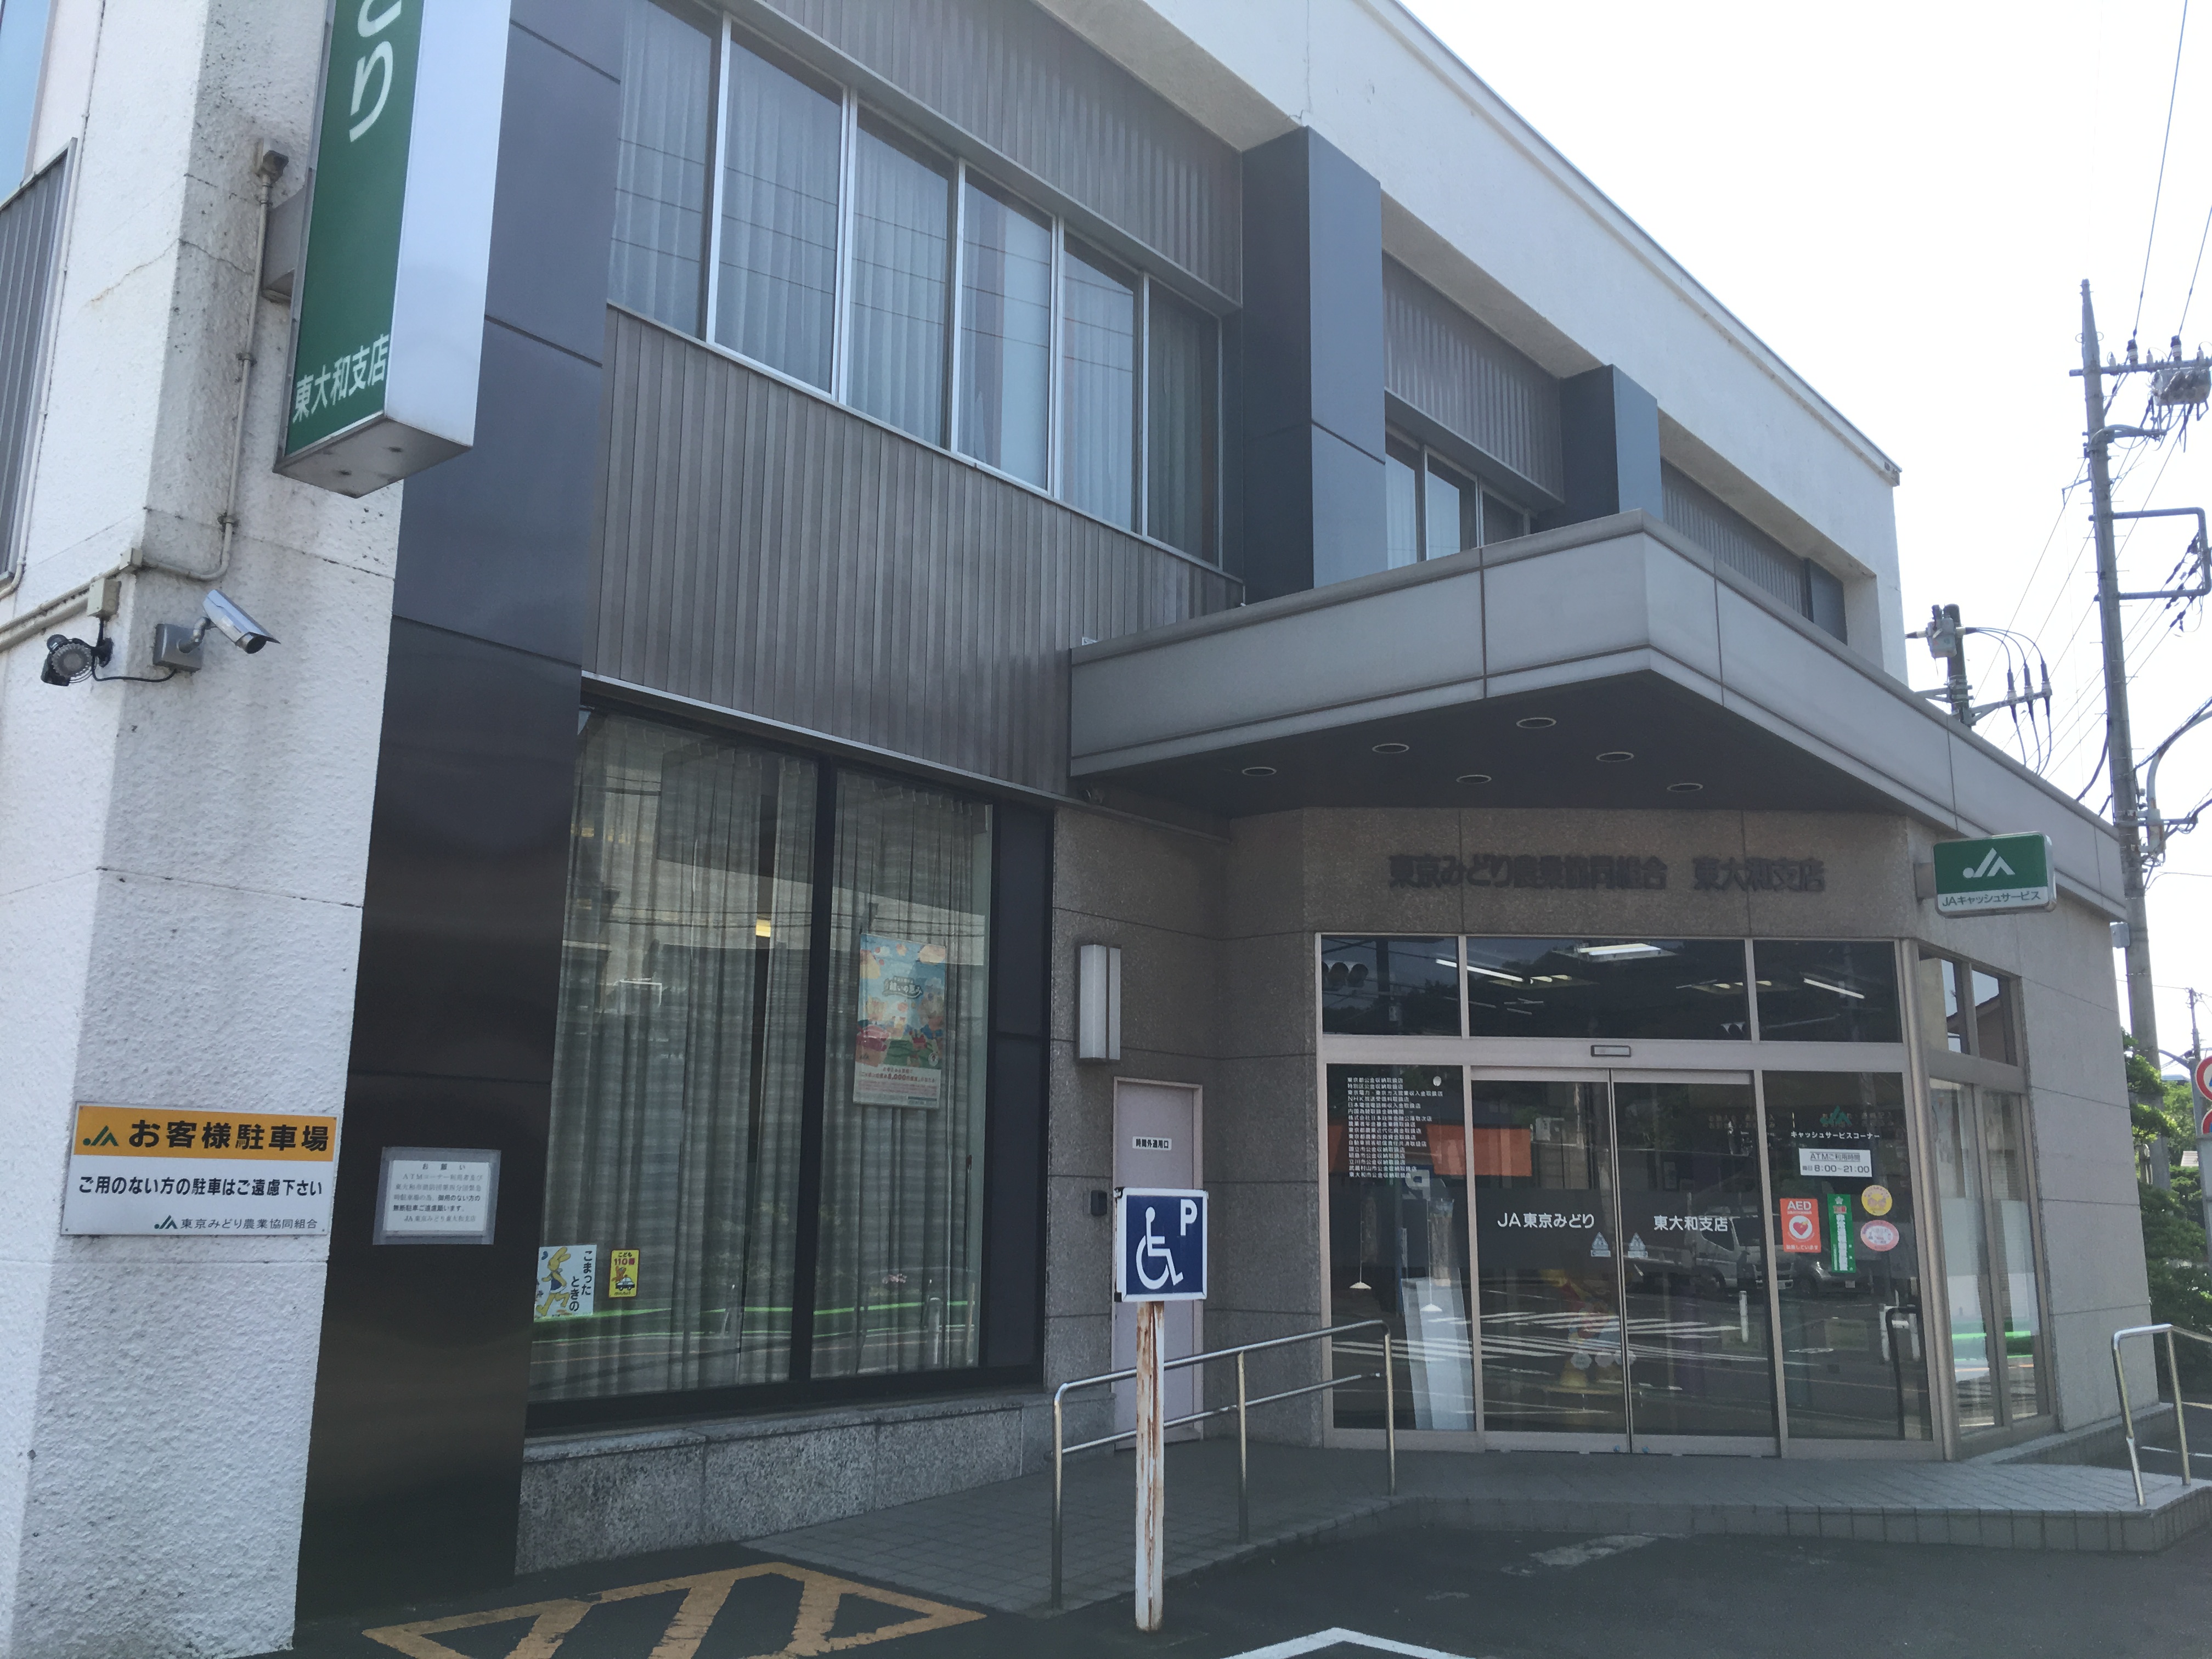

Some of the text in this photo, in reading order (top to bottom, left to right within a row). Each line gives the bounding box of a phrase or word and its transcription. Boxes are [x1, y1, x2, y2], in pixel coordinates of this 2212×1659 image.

[293, 334, 390, 424] 東大和支店
[1693, 856, 1825, 892] 東大和支店
[1942, 891, 2041, 906] JAキャッシュサービス
[129, 1120, 329, 1152] お客様駐車場
[1136, 1138, 1169, 1149] 時間外通用口
[1791, 1131, 1880, 1139] キャッシュサービスコーナー
[1810, 1153, 1860, 1161] ATMご利用時間
[79, 1176, 323, 1197] ご用のない方の駐車はご遠慮下さい
[1787, 1201, 1811, 1211] AED
[180, 1218, 318, 1229] 東京みどり農業協同組合
[1180, 1199, 1198, 1236] P
[1654, 1216, 1728, 1232] 東大和支店
[581, 1251, 592, 1295] こまった
[569, 1276, 579, 1312] ときの
